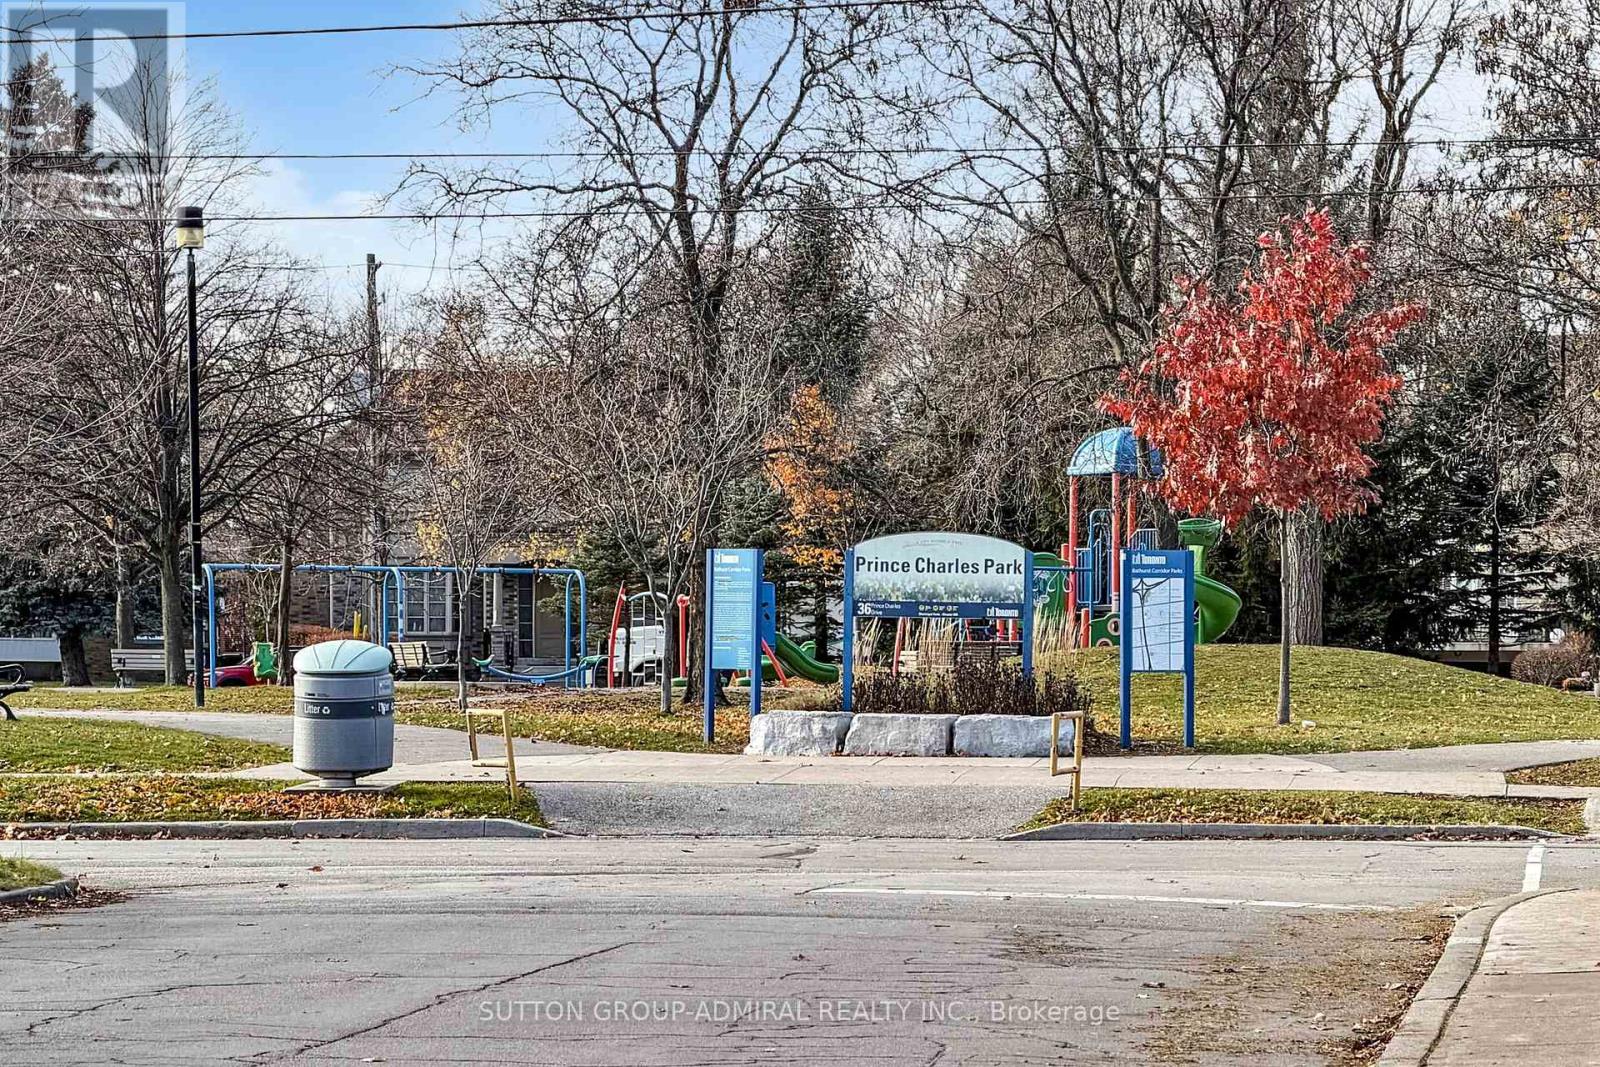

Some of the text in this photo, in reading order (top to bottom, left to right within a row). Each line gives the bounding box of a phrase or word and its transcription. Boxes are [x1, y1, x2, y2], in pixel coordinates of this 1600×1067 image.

[856, 556, 1022, 575] Prince Charles Park
[857, 603, 871, 615] 36
[304, 702, 321, 714] Litter
